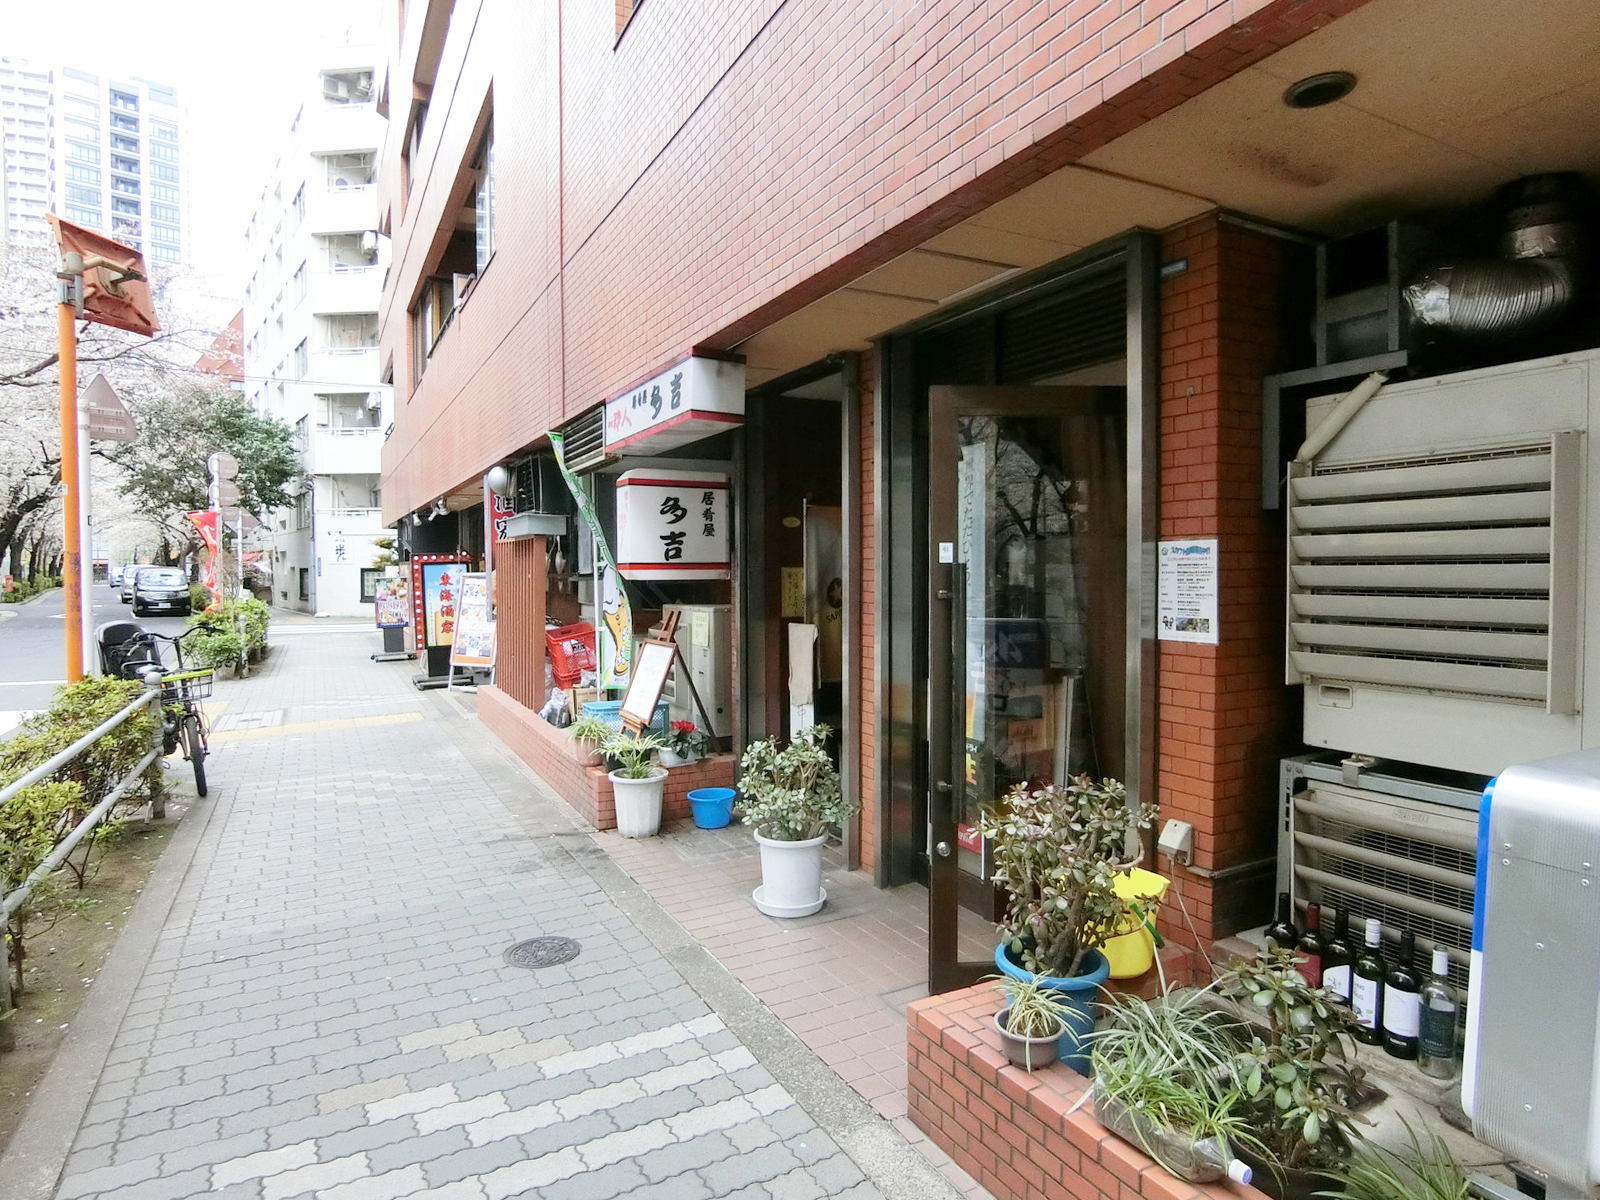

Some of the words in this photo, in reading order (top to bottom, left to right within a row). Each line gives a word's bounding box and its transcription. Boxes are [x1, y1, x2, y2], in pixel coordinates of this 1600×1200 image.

[659, 496, 687, 561] 多吉
[701, 491, 715, 537] 居肴屋
[439, 572, 455, 634] 東海酒家
